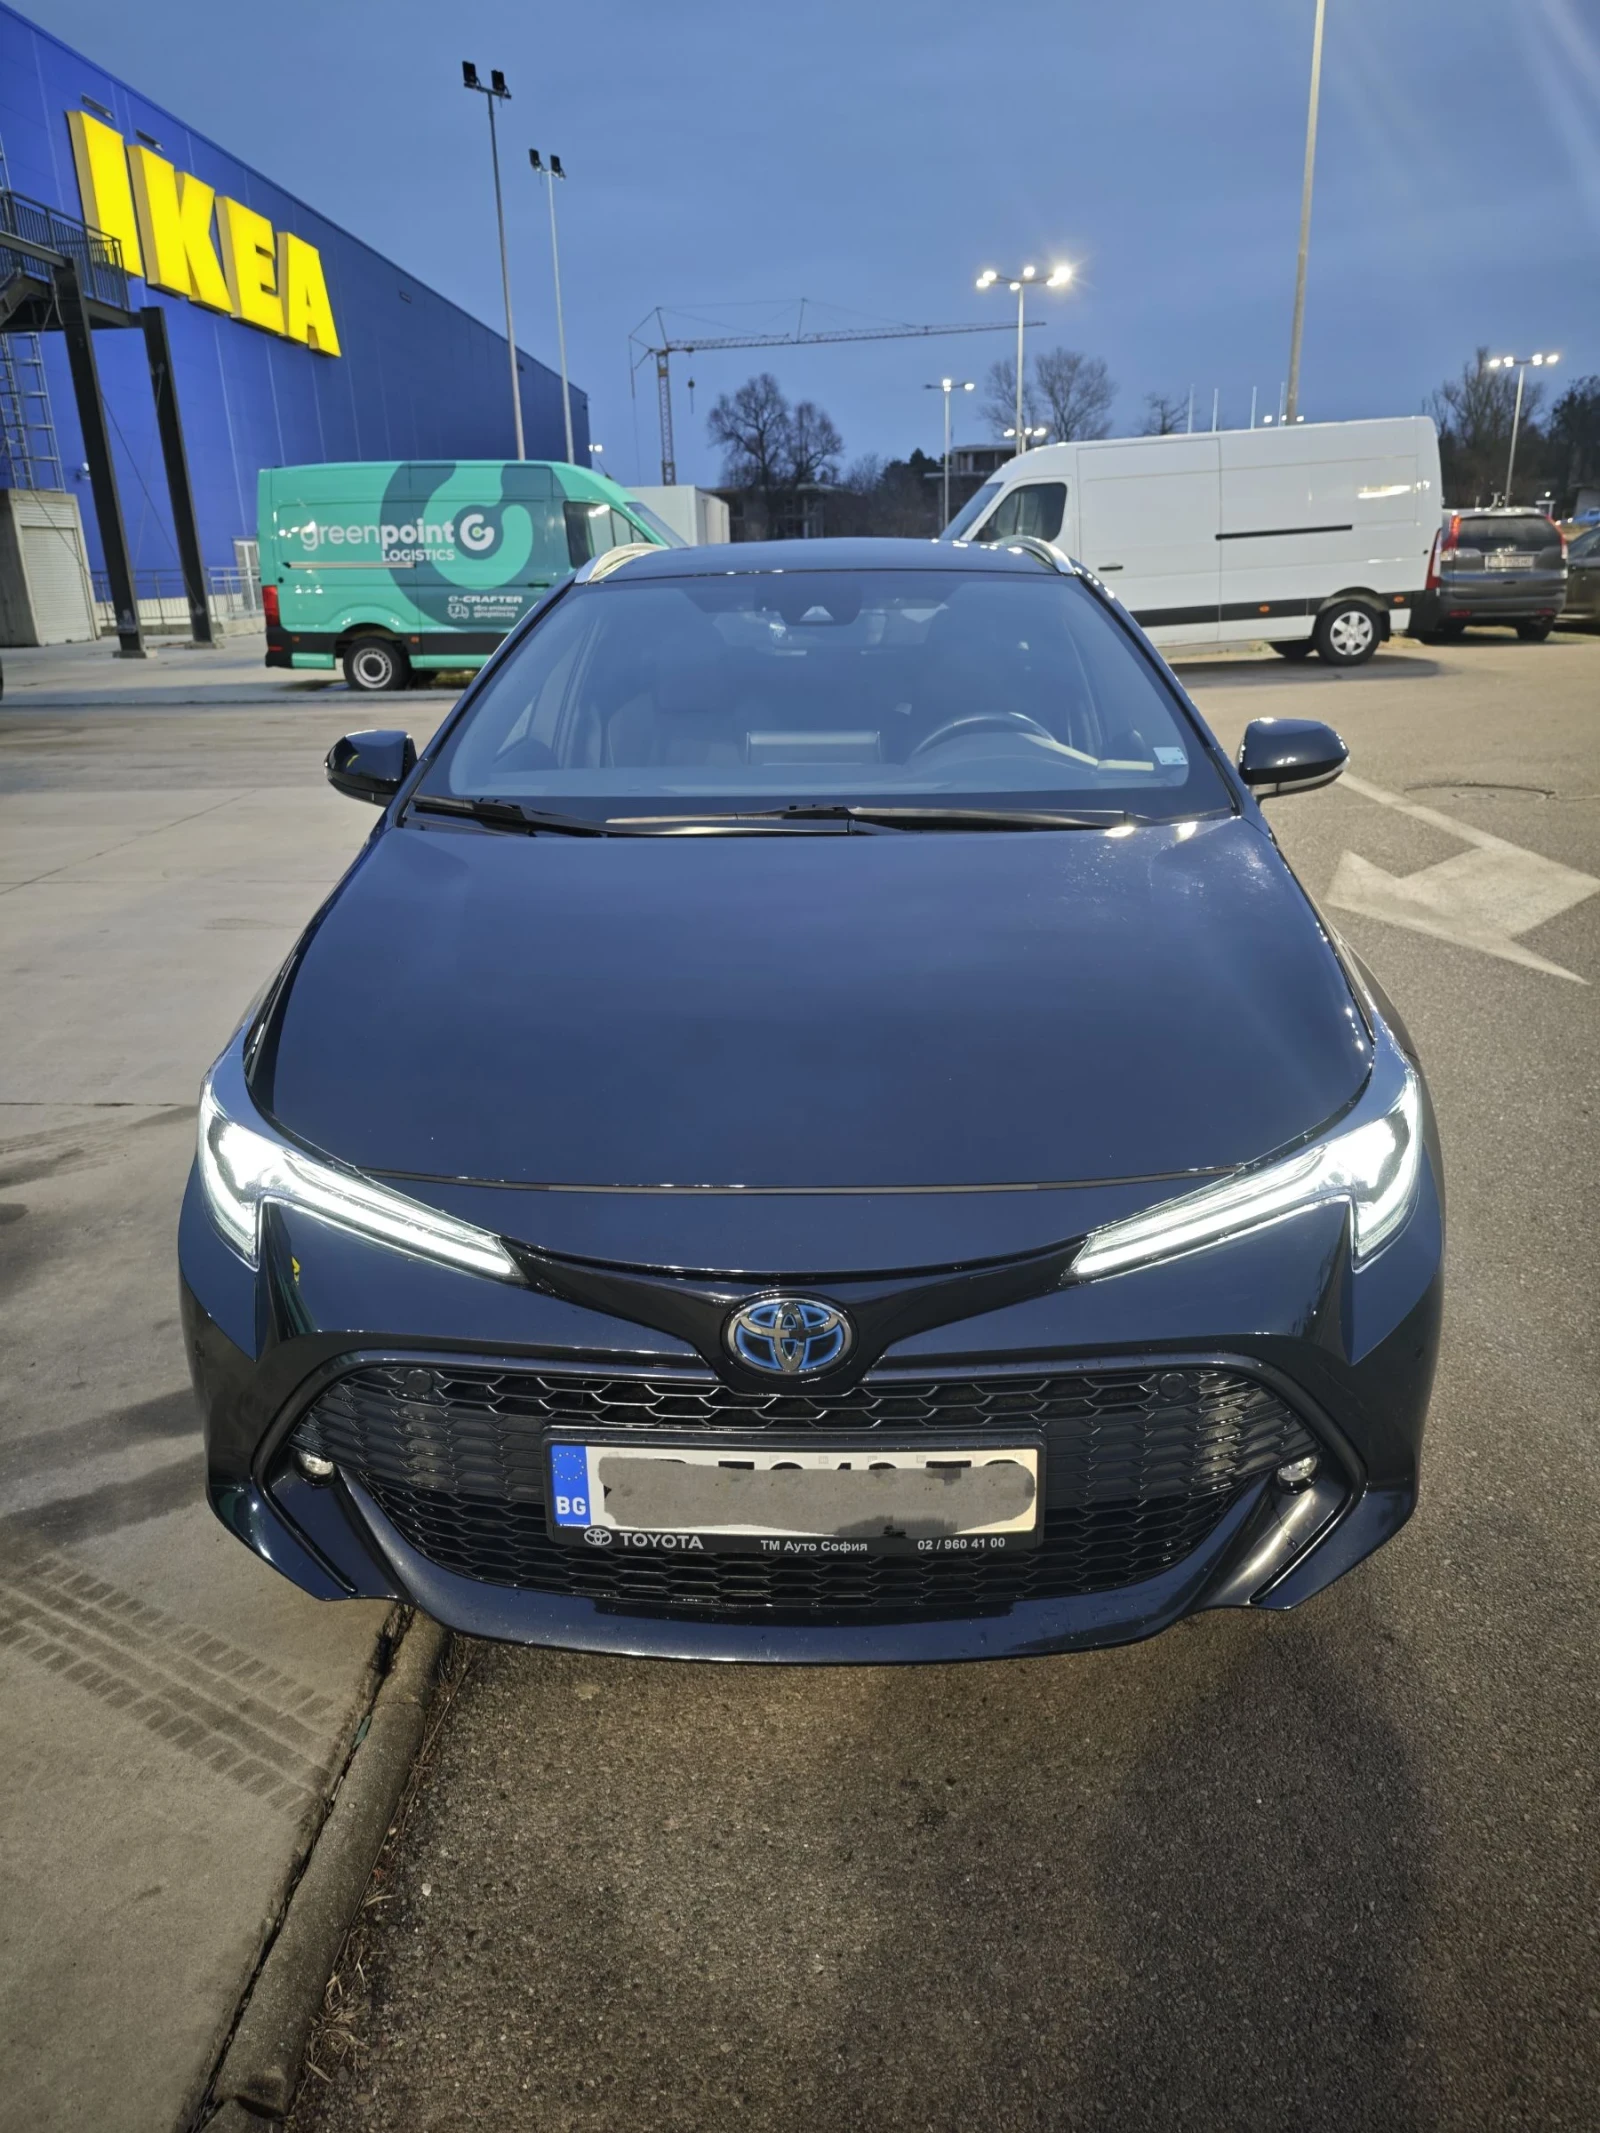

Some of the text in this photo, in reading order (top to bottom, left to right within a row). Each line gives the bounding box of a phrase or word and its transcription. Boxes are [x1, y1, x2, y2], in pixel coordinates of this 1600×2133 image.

[66, 110, 341, 358] IKEA
[300, 518, 456, 551] greenpoint
[382, 549, 455, 562] LOGISTICS
[448, 595, 523, 604] e-CRAFTER
[556, 1496, 586, 1515] BG
[619, 1532, 704, 1550] TOYOTA
[760, 1540, 868, 1554] ТМ Ауто София
[917, 1540, 933, 1550] 02
[944, 1539, 967, 1549] 960
[971, 1538, 985, 1548] 41
[990, 1537, 1006, 1548] 00
